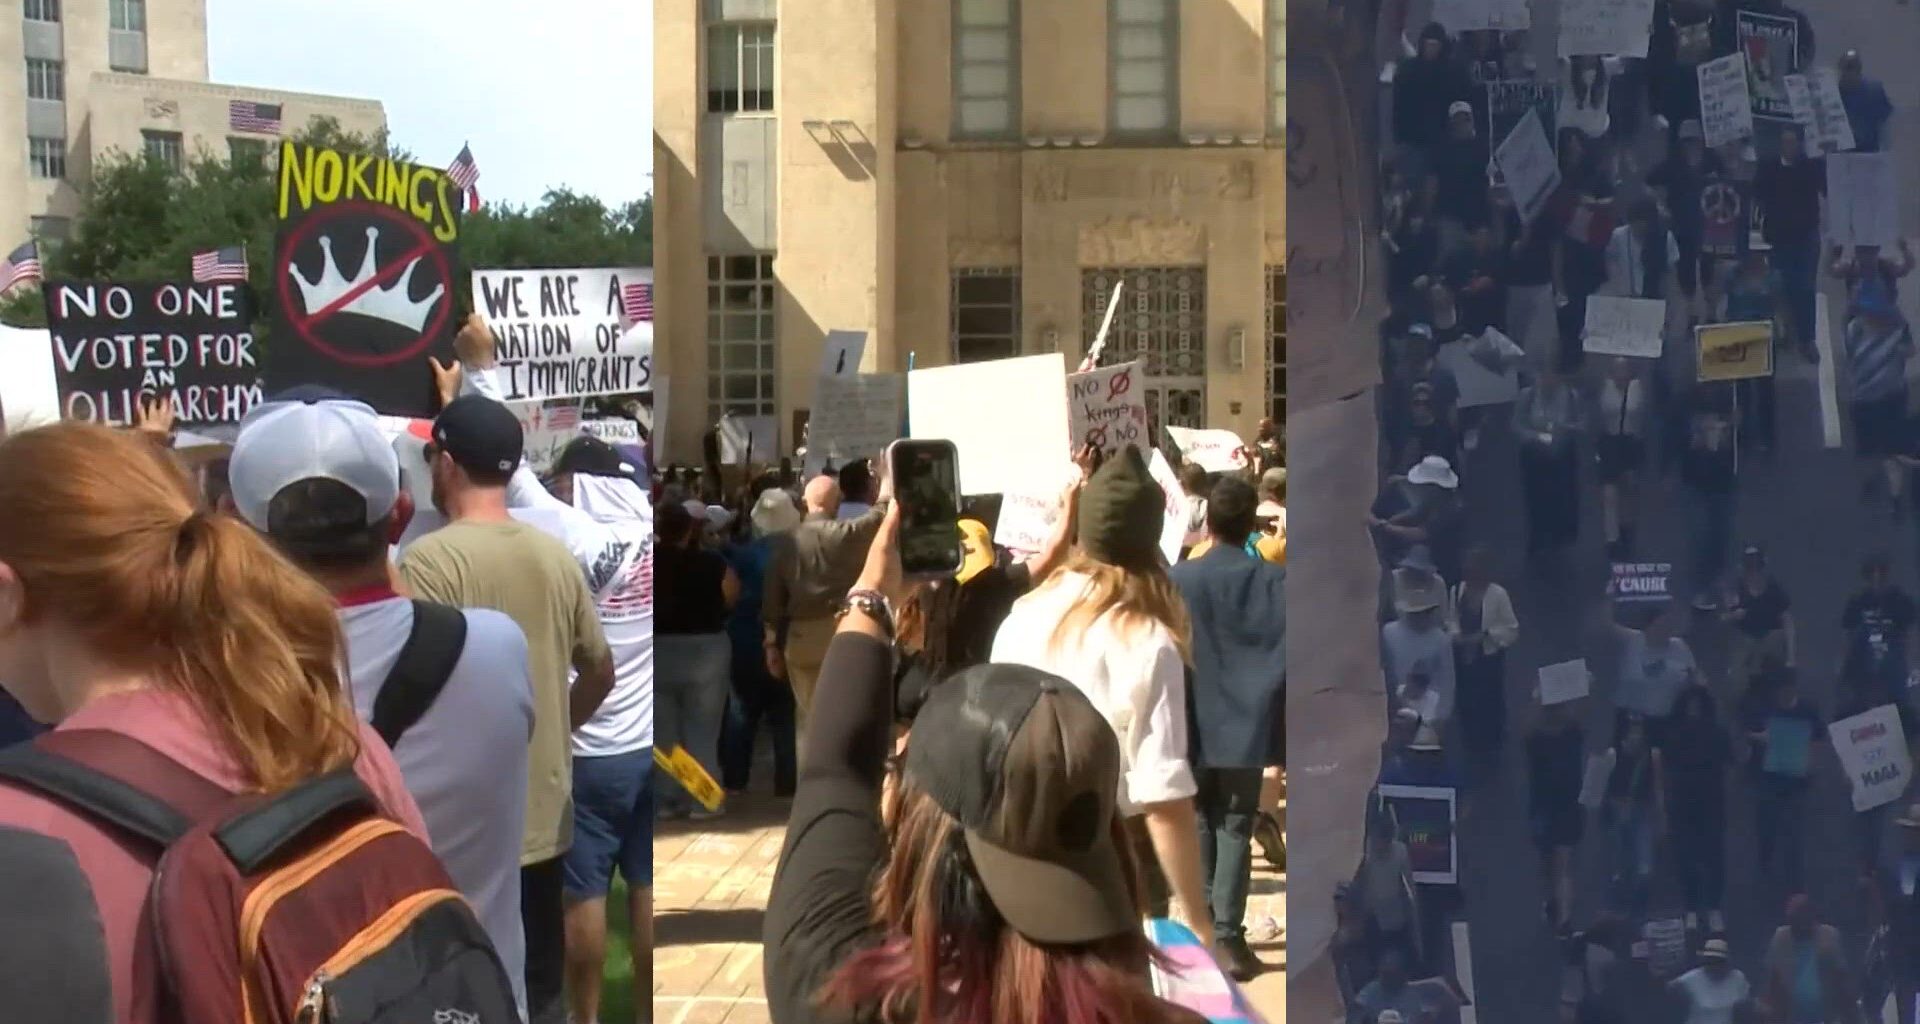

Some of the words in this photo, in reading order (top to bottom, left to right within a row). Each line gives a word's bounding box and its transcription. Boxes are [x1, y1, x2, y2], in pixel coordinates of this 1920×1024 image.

[280, 140, 343, 219] NO
[346, 154, 456, 242] KINGS
[60, 285, 133, 319] NO
[157, 284, 238, 319] ONE
[481, 275, 529, 320] WE
[540, 275, 581, 317] ARE
[607, 274, 626, 316] A
[54, 334, 188, 372] VOTED
[199, 333, 256, 367] FOR
[489, 323, 571, 360] NATION
[596, 323, 620, 354] OF
[141, 369, 176, 387] AN
[500, 354, 650, 400] IMMIGRANTS
[1074, 380, 1099, 400] NO
[1115, 422, 1138, 441] NO
